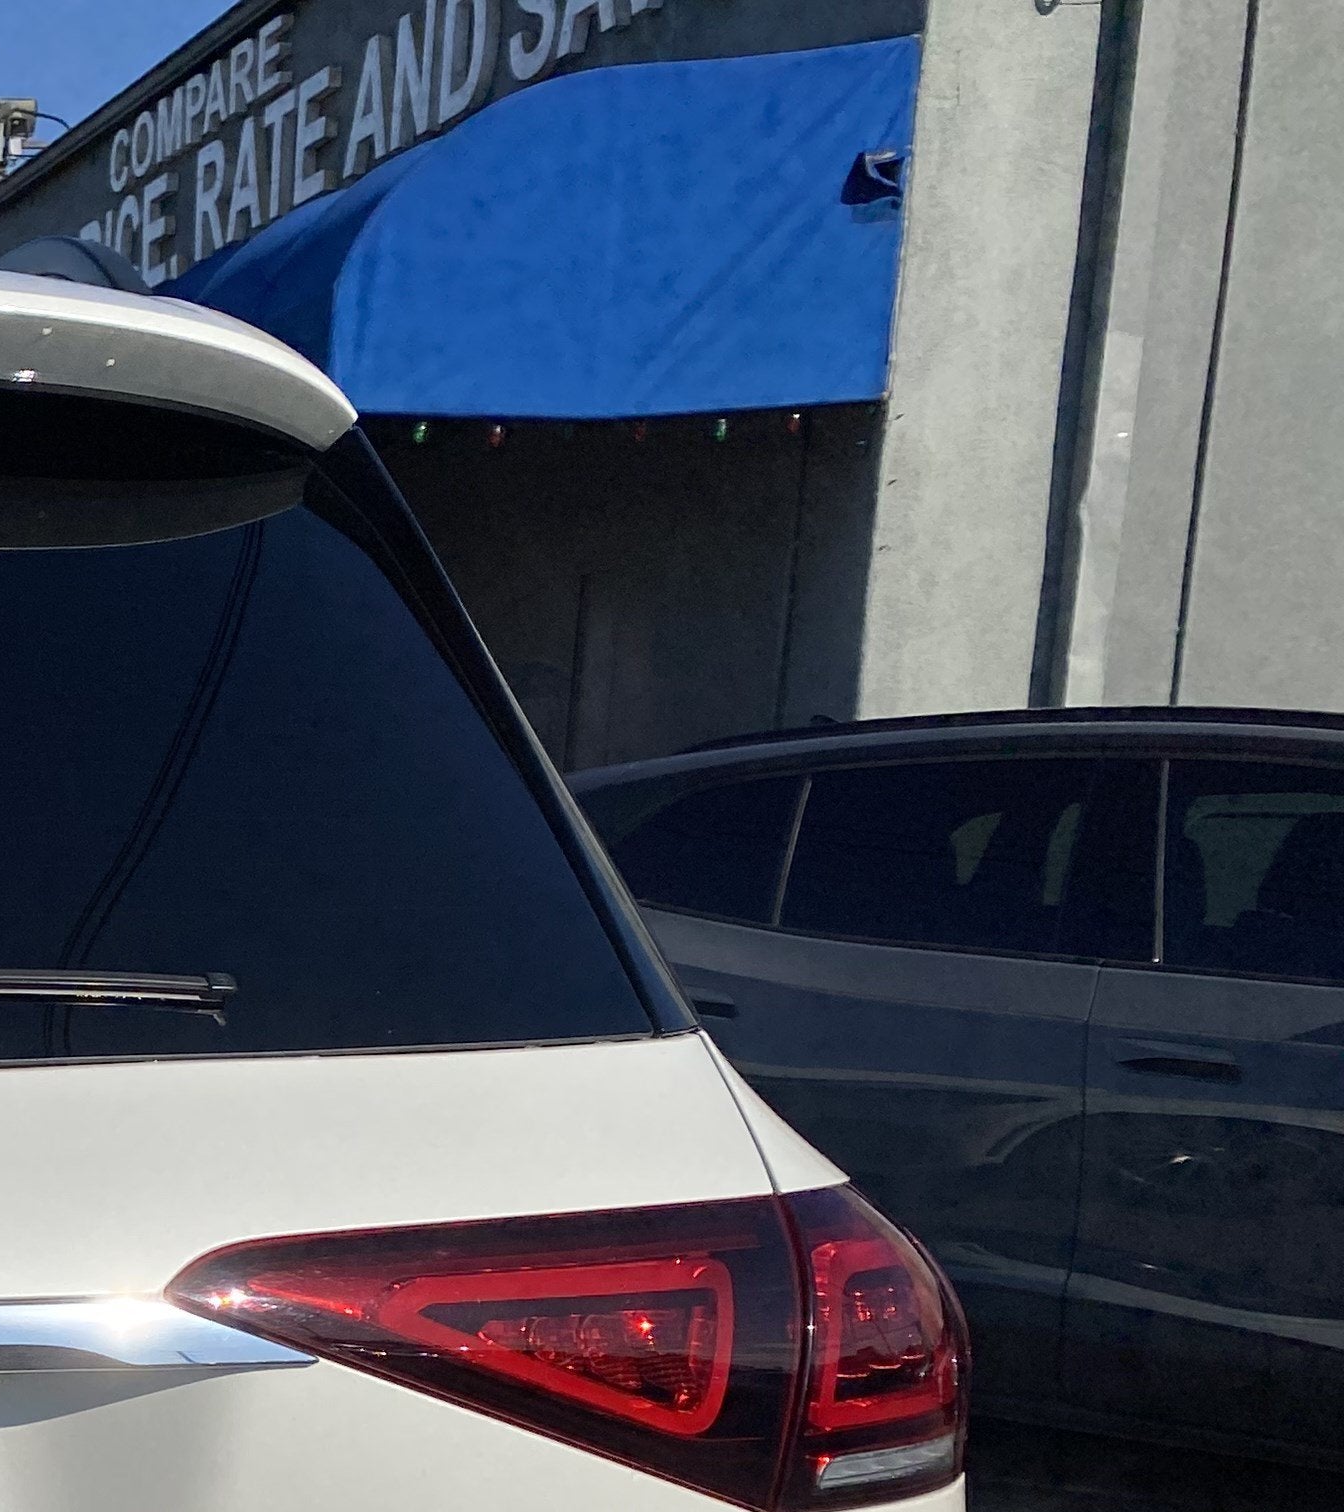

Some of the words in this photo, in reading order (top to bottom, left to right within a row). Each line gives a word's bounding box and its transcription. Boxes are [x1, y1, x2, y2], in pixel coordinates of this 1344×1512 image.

[110, 14, 294, 191] COMPARE
[194, 66, 339, 262] RATE
[343, 0, 492, 179] AND
